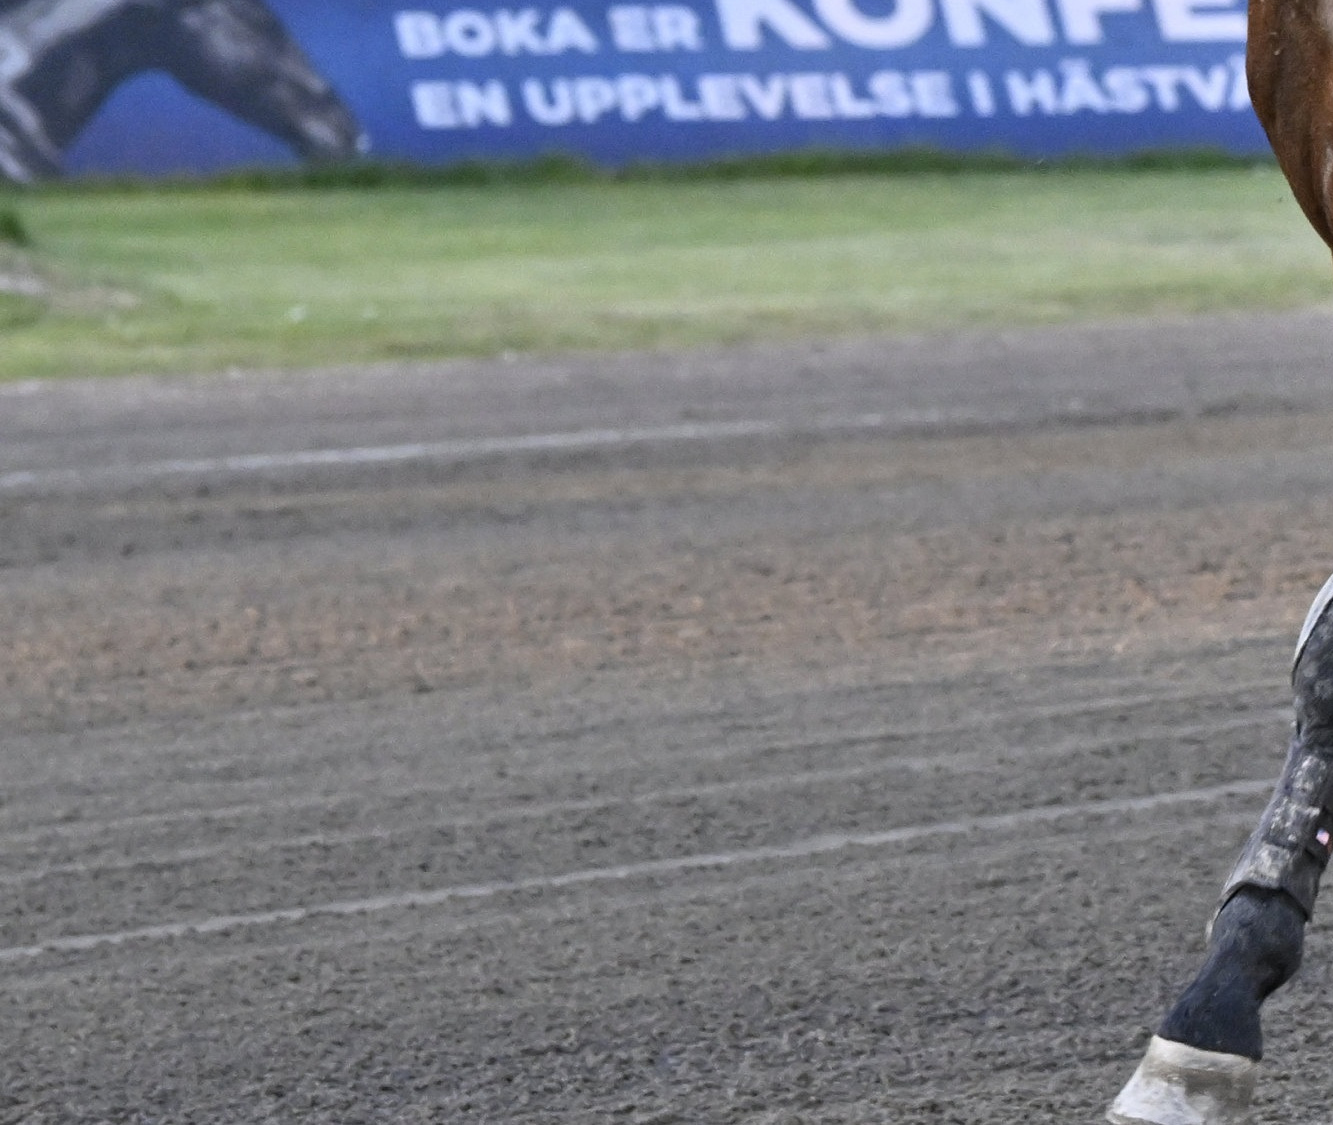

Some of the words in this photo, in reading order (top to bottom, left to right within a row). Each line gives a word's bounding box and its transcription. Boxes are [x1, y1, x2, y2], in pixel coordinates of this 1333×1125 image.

[397, 7, 598, 57] BOKA
[610, 4, 702, 51] ER
[413, 79, 514, 128] EN
[525, 71, 957, 125] UPPLEVELSE
[970, 71, 995, 116] I
